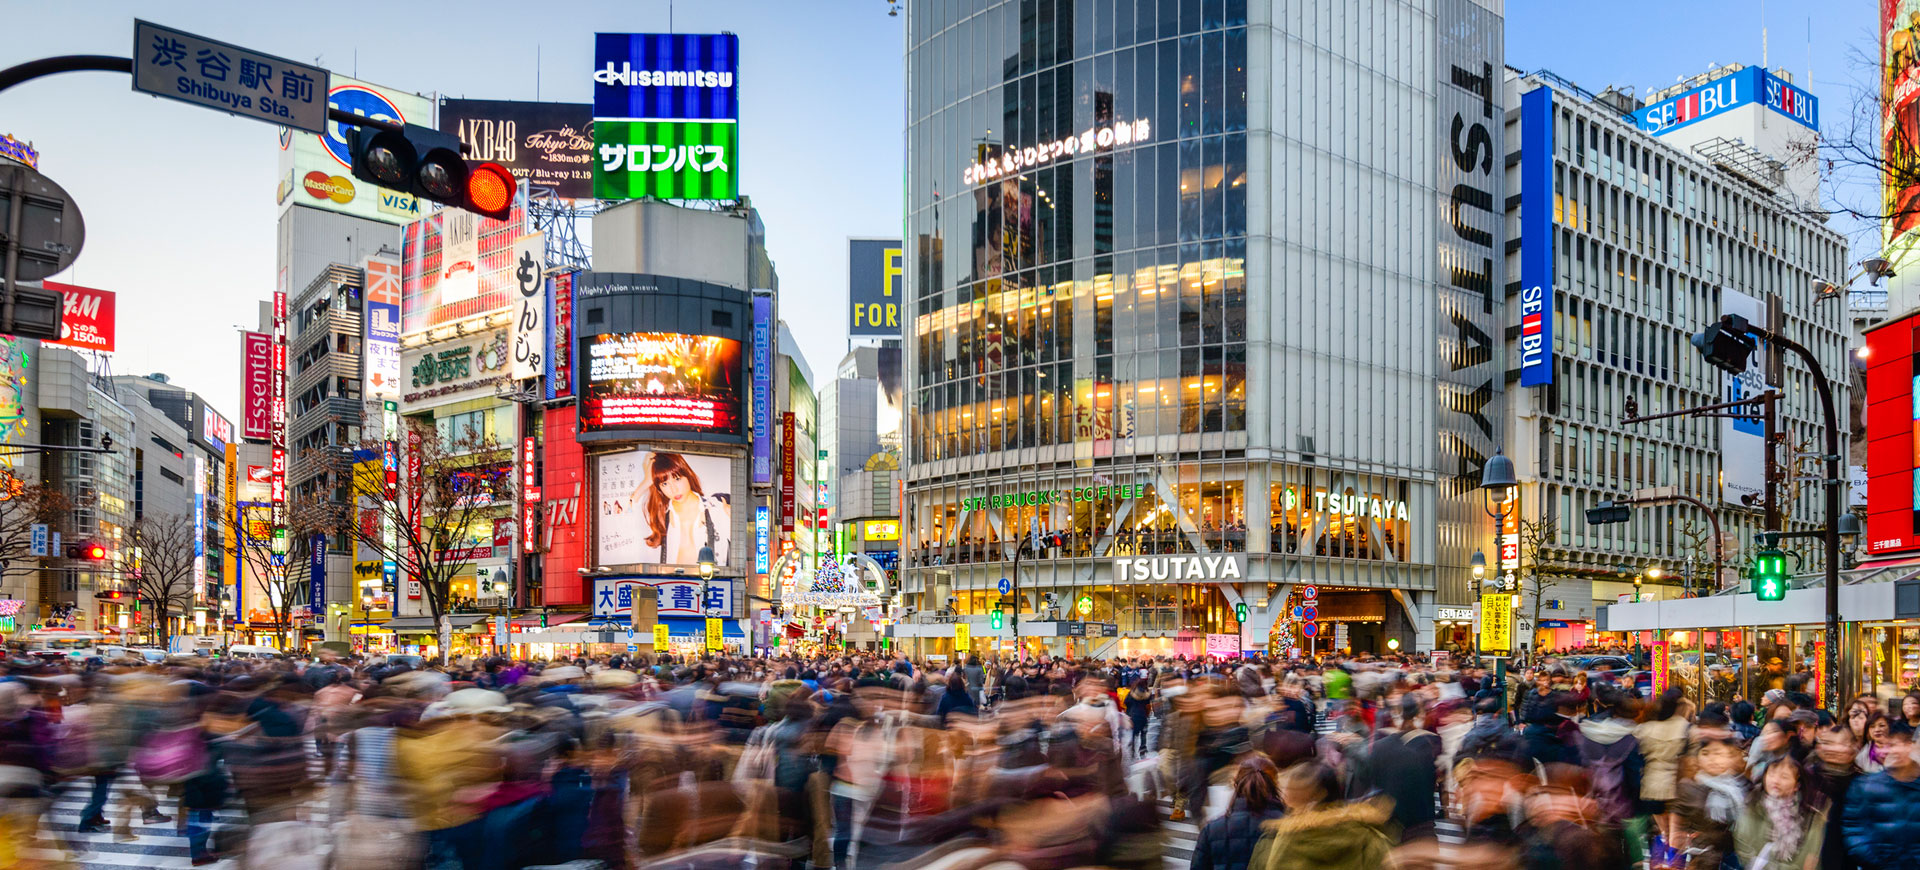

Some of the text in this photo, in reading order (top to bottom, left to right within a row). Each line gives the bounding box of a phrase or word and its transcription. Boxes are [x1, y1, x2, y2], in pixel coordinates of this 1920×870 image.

[152, 34, 314, 104] 渋谷駅前
[593, 61, 733, 88] Hisamitsu
[177, 76, 295, 119] Shibuya Sta.
[1646, 78, 1739, 135] SEIBU
[1766, 78, 1813, 125] SEIBU
[458, 119, 516, 162] AKB48
[524, 134, 569, 153] Tokyo
[599, 143, 728, 173] サロンパス
[304, 178, 354, 196] MasterCard
[382, 193, 419, 214] VISA
[580, 286, 604, 297] Mighty
[604, 284, 628, 294] Vision
[1451, 61, 1494, 498] TSUTAYA
[63, 291, 102, 320] H&M
[515, 250, 542, 373] もんじゃ
[854, 303, 902, 327] FOR
[72, 331, 107, 345] 150m
[1522, 286, 1542, 369] SEIBU
[247, 335, 267, 435] Essential
[755, 316, 769, 437] Taisei neon
[1727, 385, 1761, 425] Life
[784, 415, 793, 481] クスリのことなら
[783, 486, 794, 526] 三千里
[963, 483, 1144, 512] STARBUCKS COFFEE
[1315, 491, 1408, 521] TSUTAYA
[1117, 556, 1241, 582] TSUTAYA
[1439, 609, 1472, 618] TSUTAYA
